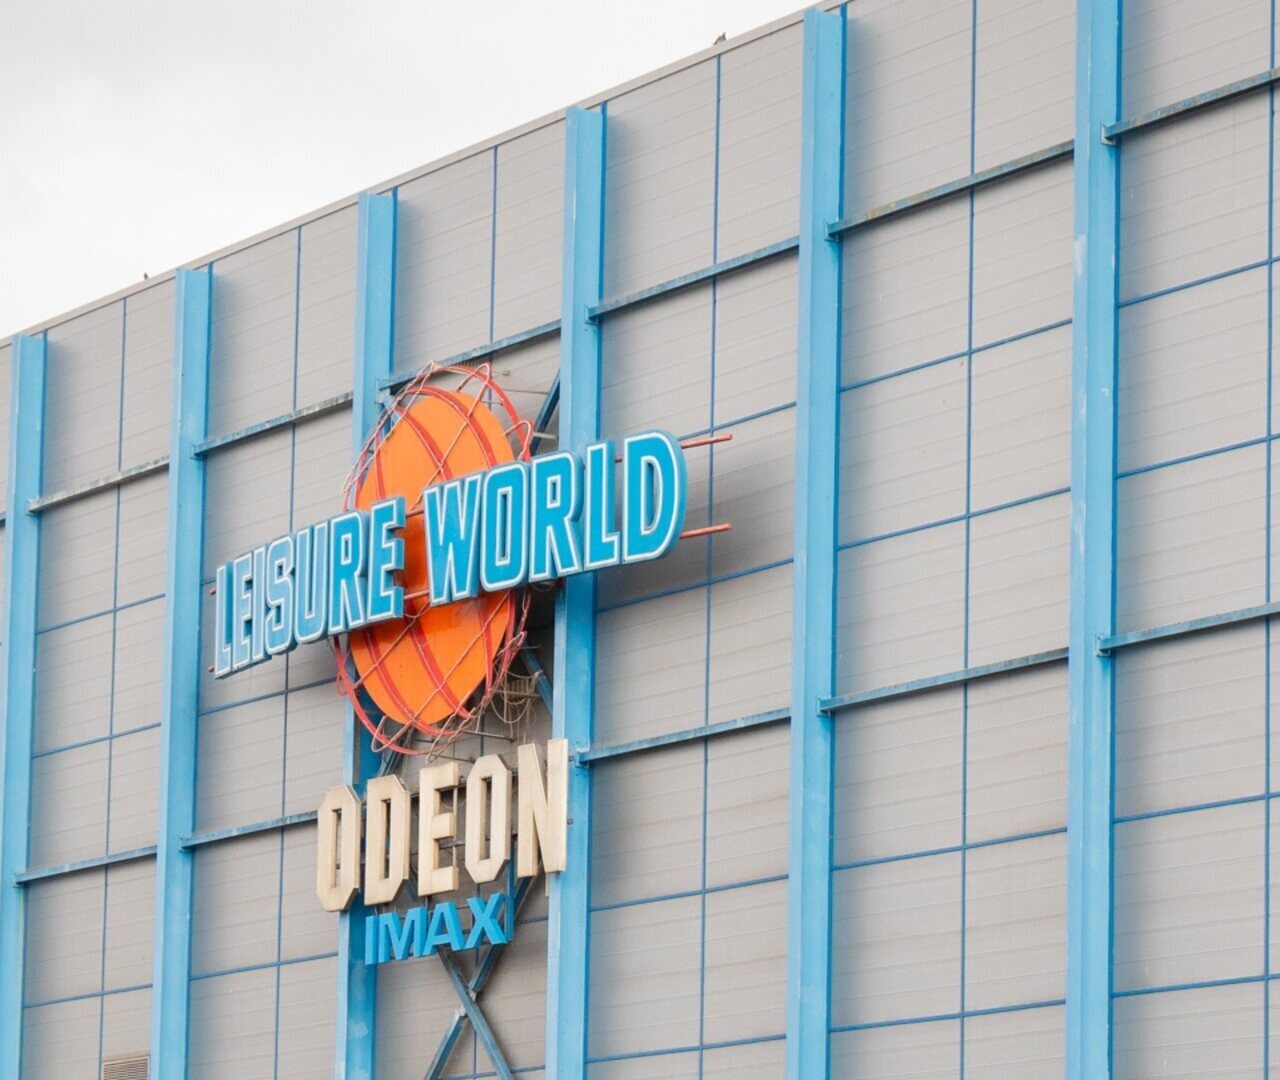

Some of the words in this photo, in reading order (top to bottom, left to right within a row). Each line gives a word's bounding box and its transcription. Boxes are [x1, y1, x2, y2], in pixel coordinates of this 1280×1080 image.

[213, 496, 406, 680] LEISURE
[423, 430, 688, 606] WORLD
[316, 738, 569, 913] ODEON
[365, 892, 514, 966] IMAX
